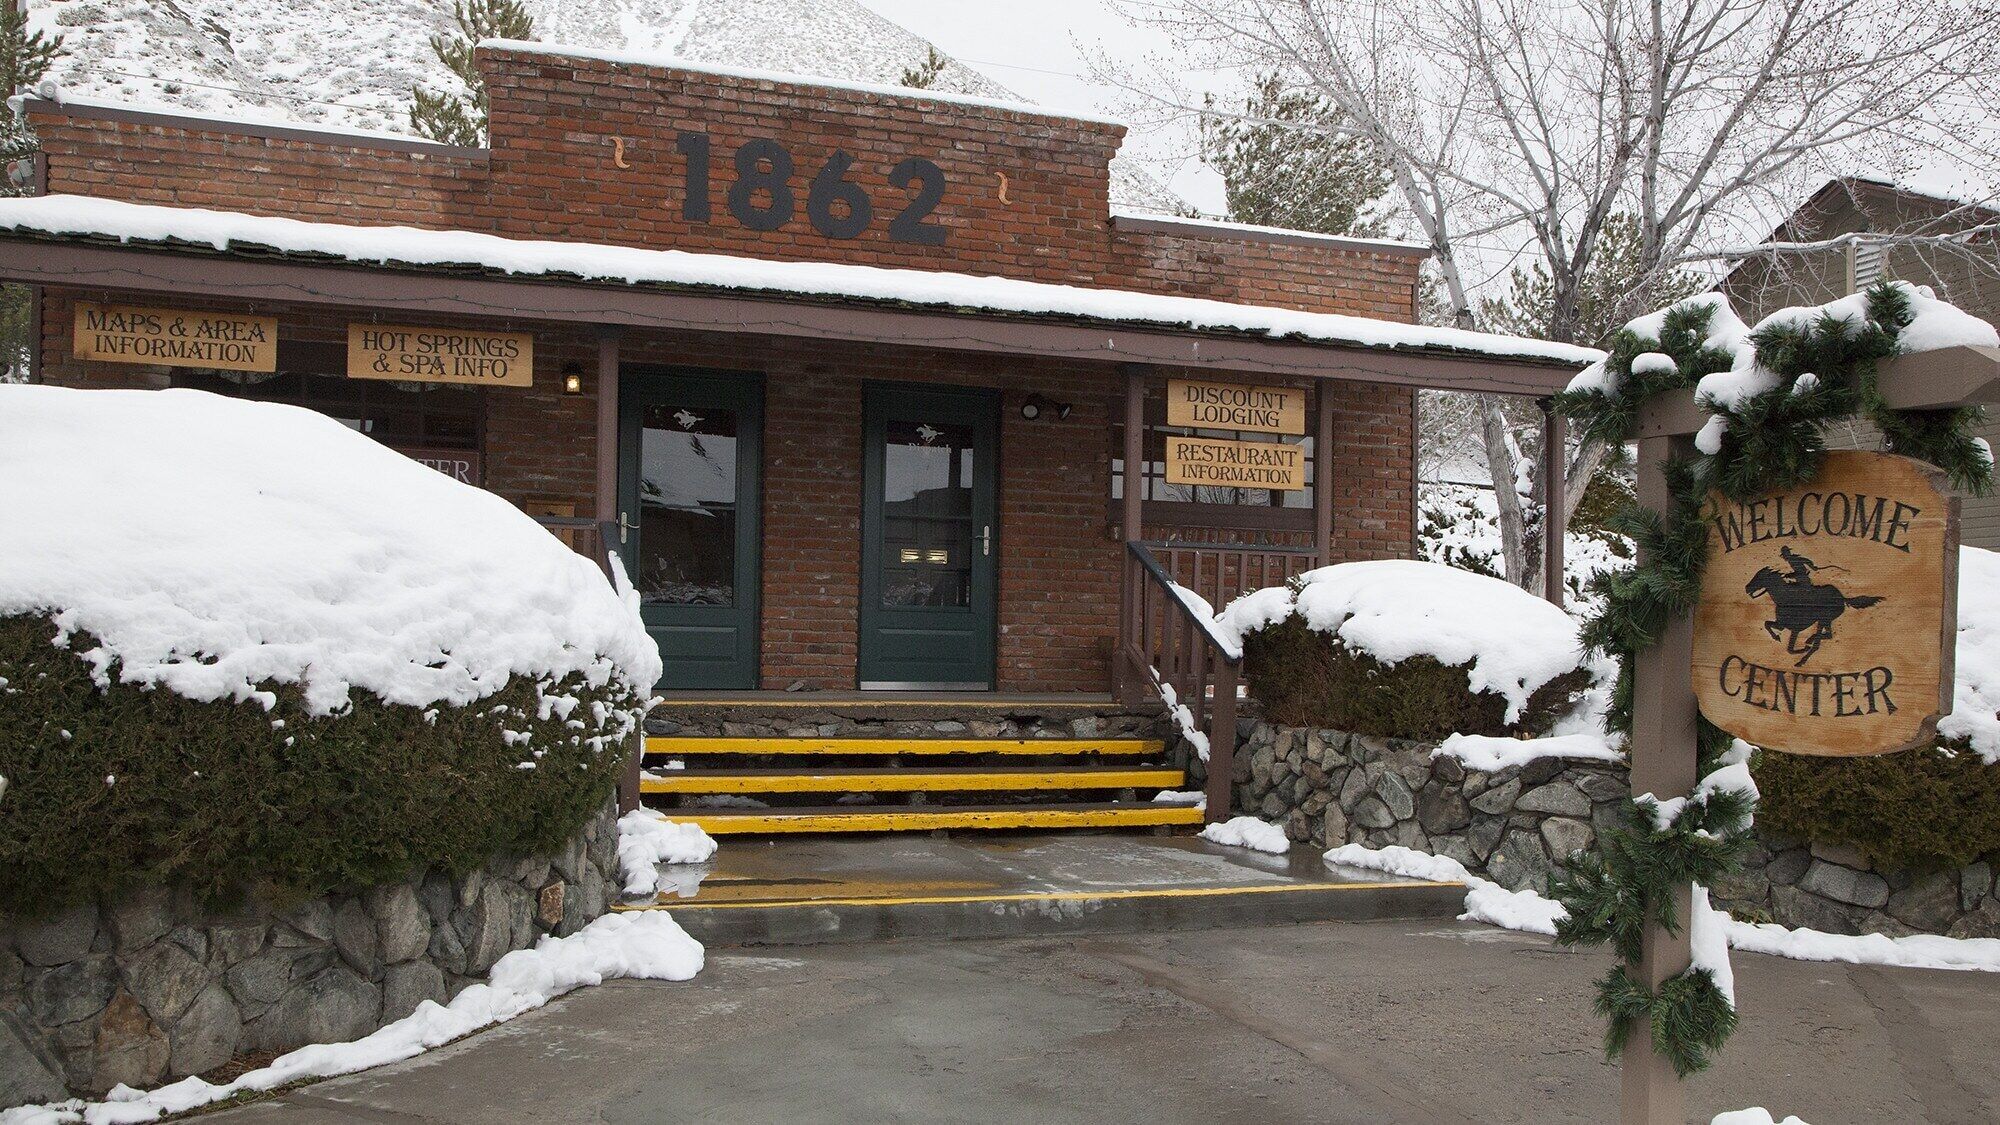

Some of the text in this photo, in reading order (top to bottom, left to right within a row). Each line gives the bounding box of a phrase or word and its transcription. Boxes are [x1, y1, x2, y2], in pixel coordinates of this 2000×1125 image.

[677, 132, 947, 246] 1862
[86, 310, 266, 342] MAPS & AREA
[95, 334, 257, 363] INFORMATION
[362, 330, 519, 358] HOT SPRINGS
[372, 353, 508, 379] & SPA INFO
[1186, 385, 1288, 410] DISCOUNT
[1192, 405, 1279, 427] LODGING
[1176, 443, 1297, 467] RESTAURANT
[1182, 464, 1291, 484] INFORMATION
[1715, 492, 1921, 554] WELCOME
[1719, 654, 1899, 718] CENTER
